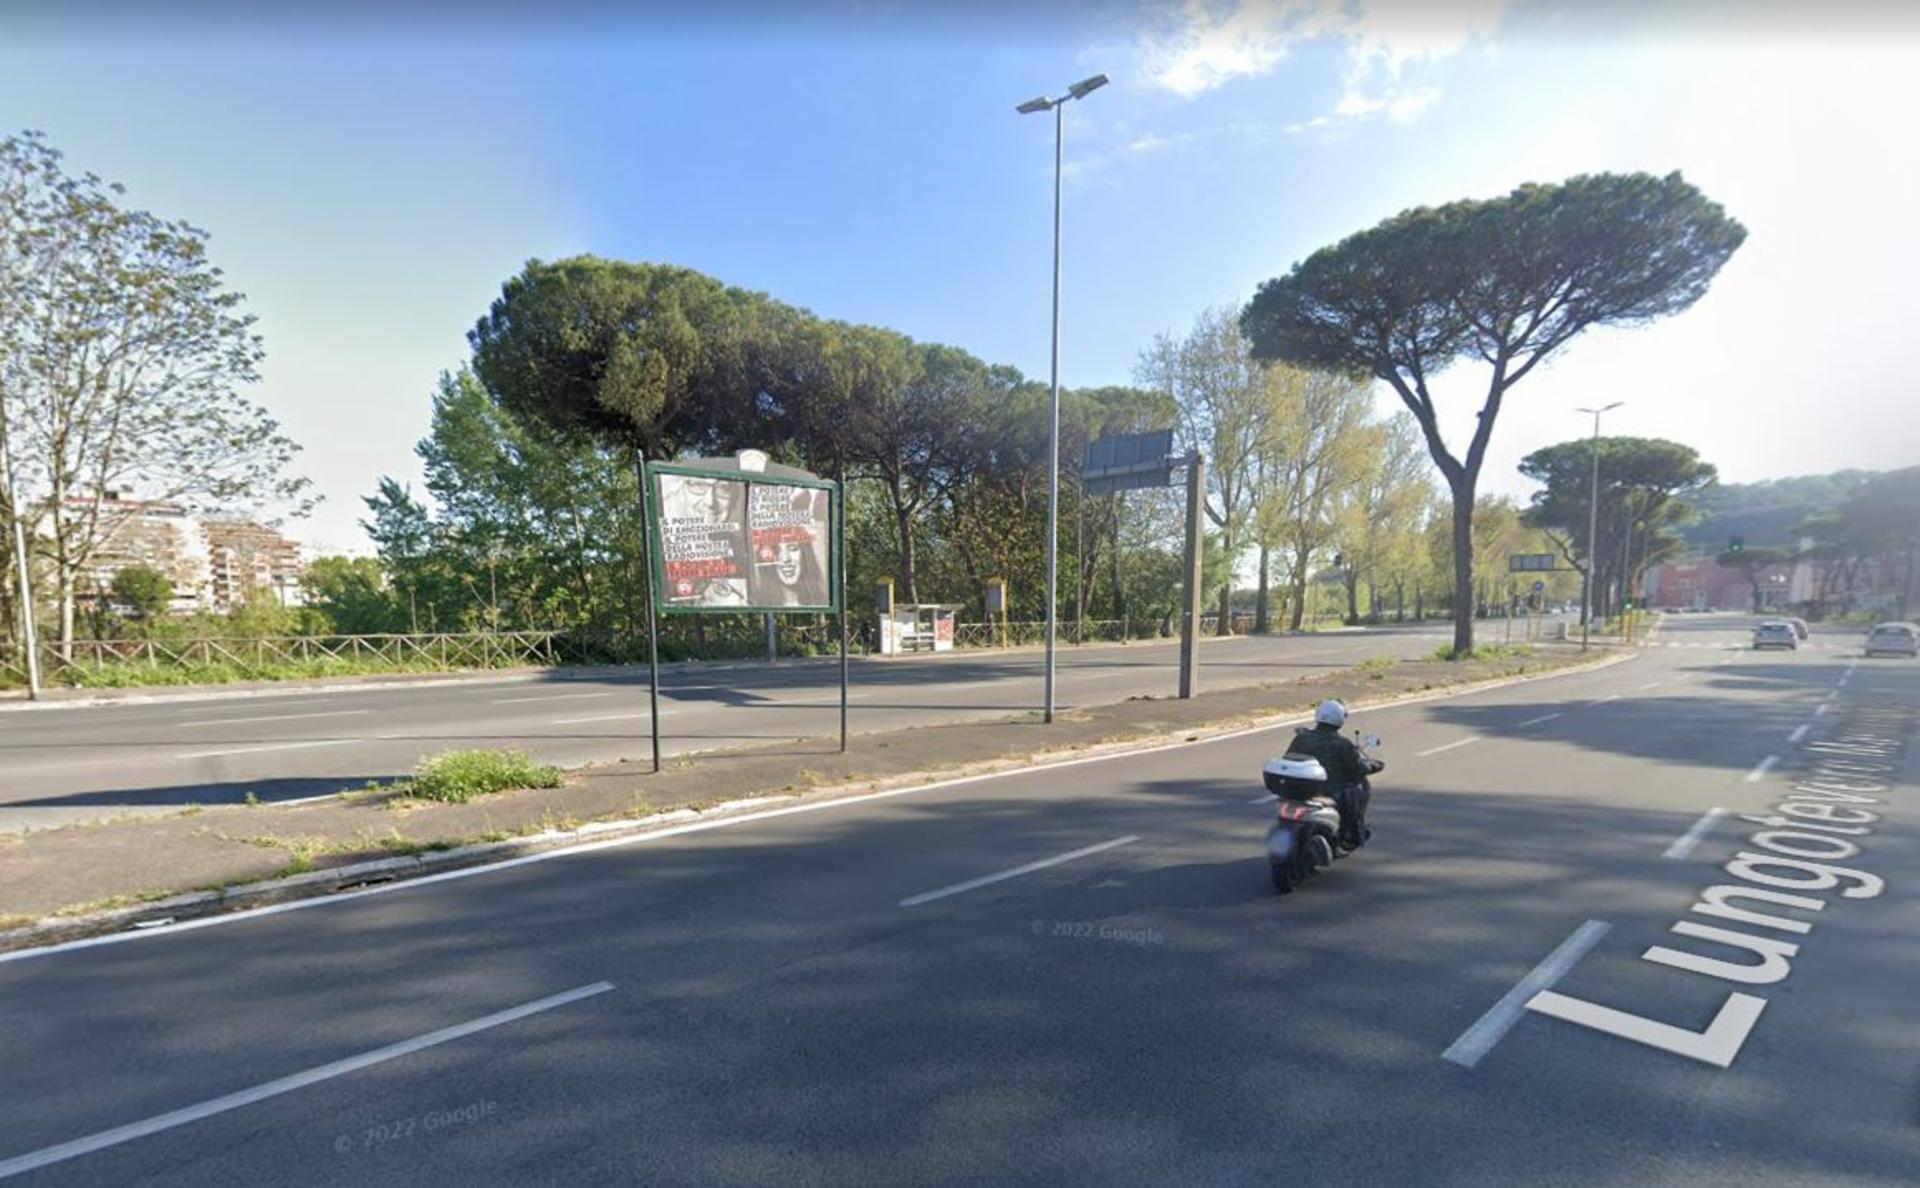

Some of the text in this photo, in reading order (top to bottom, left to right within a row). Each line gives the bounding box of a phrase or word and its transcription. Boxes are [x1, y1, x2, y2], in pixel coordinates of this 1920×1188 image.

[672, 517, 705, 526] POTERE
[675, 534, 706, 543] POTERE
[666, 544, 693, 553] DELLA
